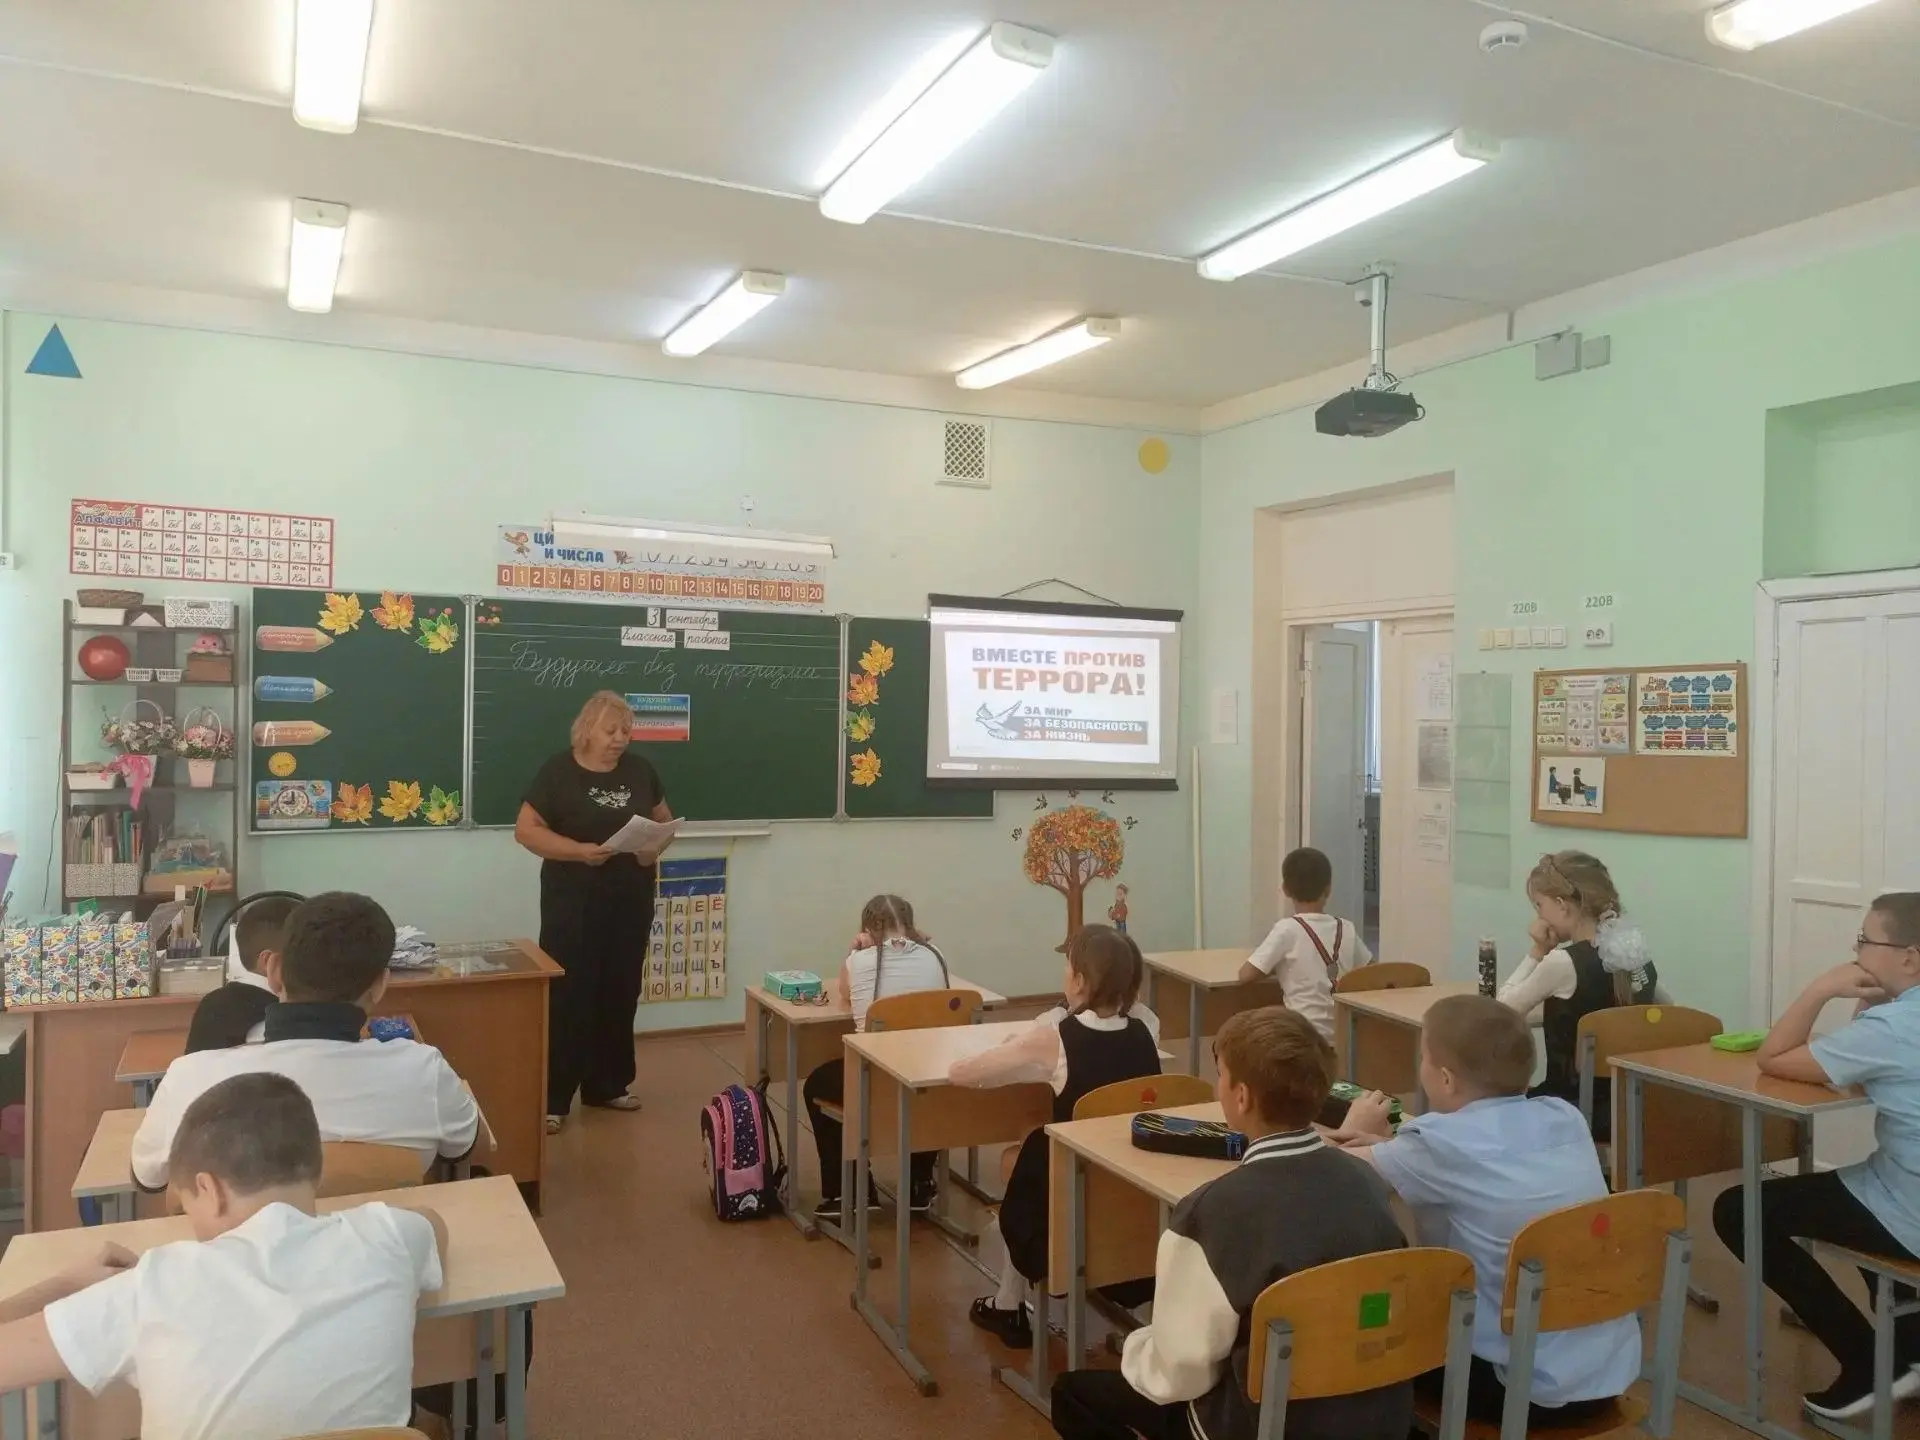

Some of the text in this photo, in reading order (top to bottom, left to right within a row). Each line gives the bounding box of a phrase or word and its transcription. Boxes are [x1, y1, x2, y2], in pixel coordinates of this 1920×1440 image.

[545, 548, 604, 562] И ЧИСЛА
[502, 571, 821, 599] 0 1 2 3 4 5 6 7 8 9 10 11 12 13 14 15 16 17 18 19 20
[648, 609, 717, 629] 3 сентября
[622, 628, 728, 648] Классная работа
[972, 648, 1145, 667] ВМЕСТЕ ПРОТИВ
[973, 668, 1146, 695] ТЕРРОРА!
[1024, 706, 1072, 716] ЗА МИР
[1024, 718, 1142, 731] ЗА БЕЗОПАСНОСТЬ
[1024, 730, 1090, 742] ЗА ЖИЗНЬ
